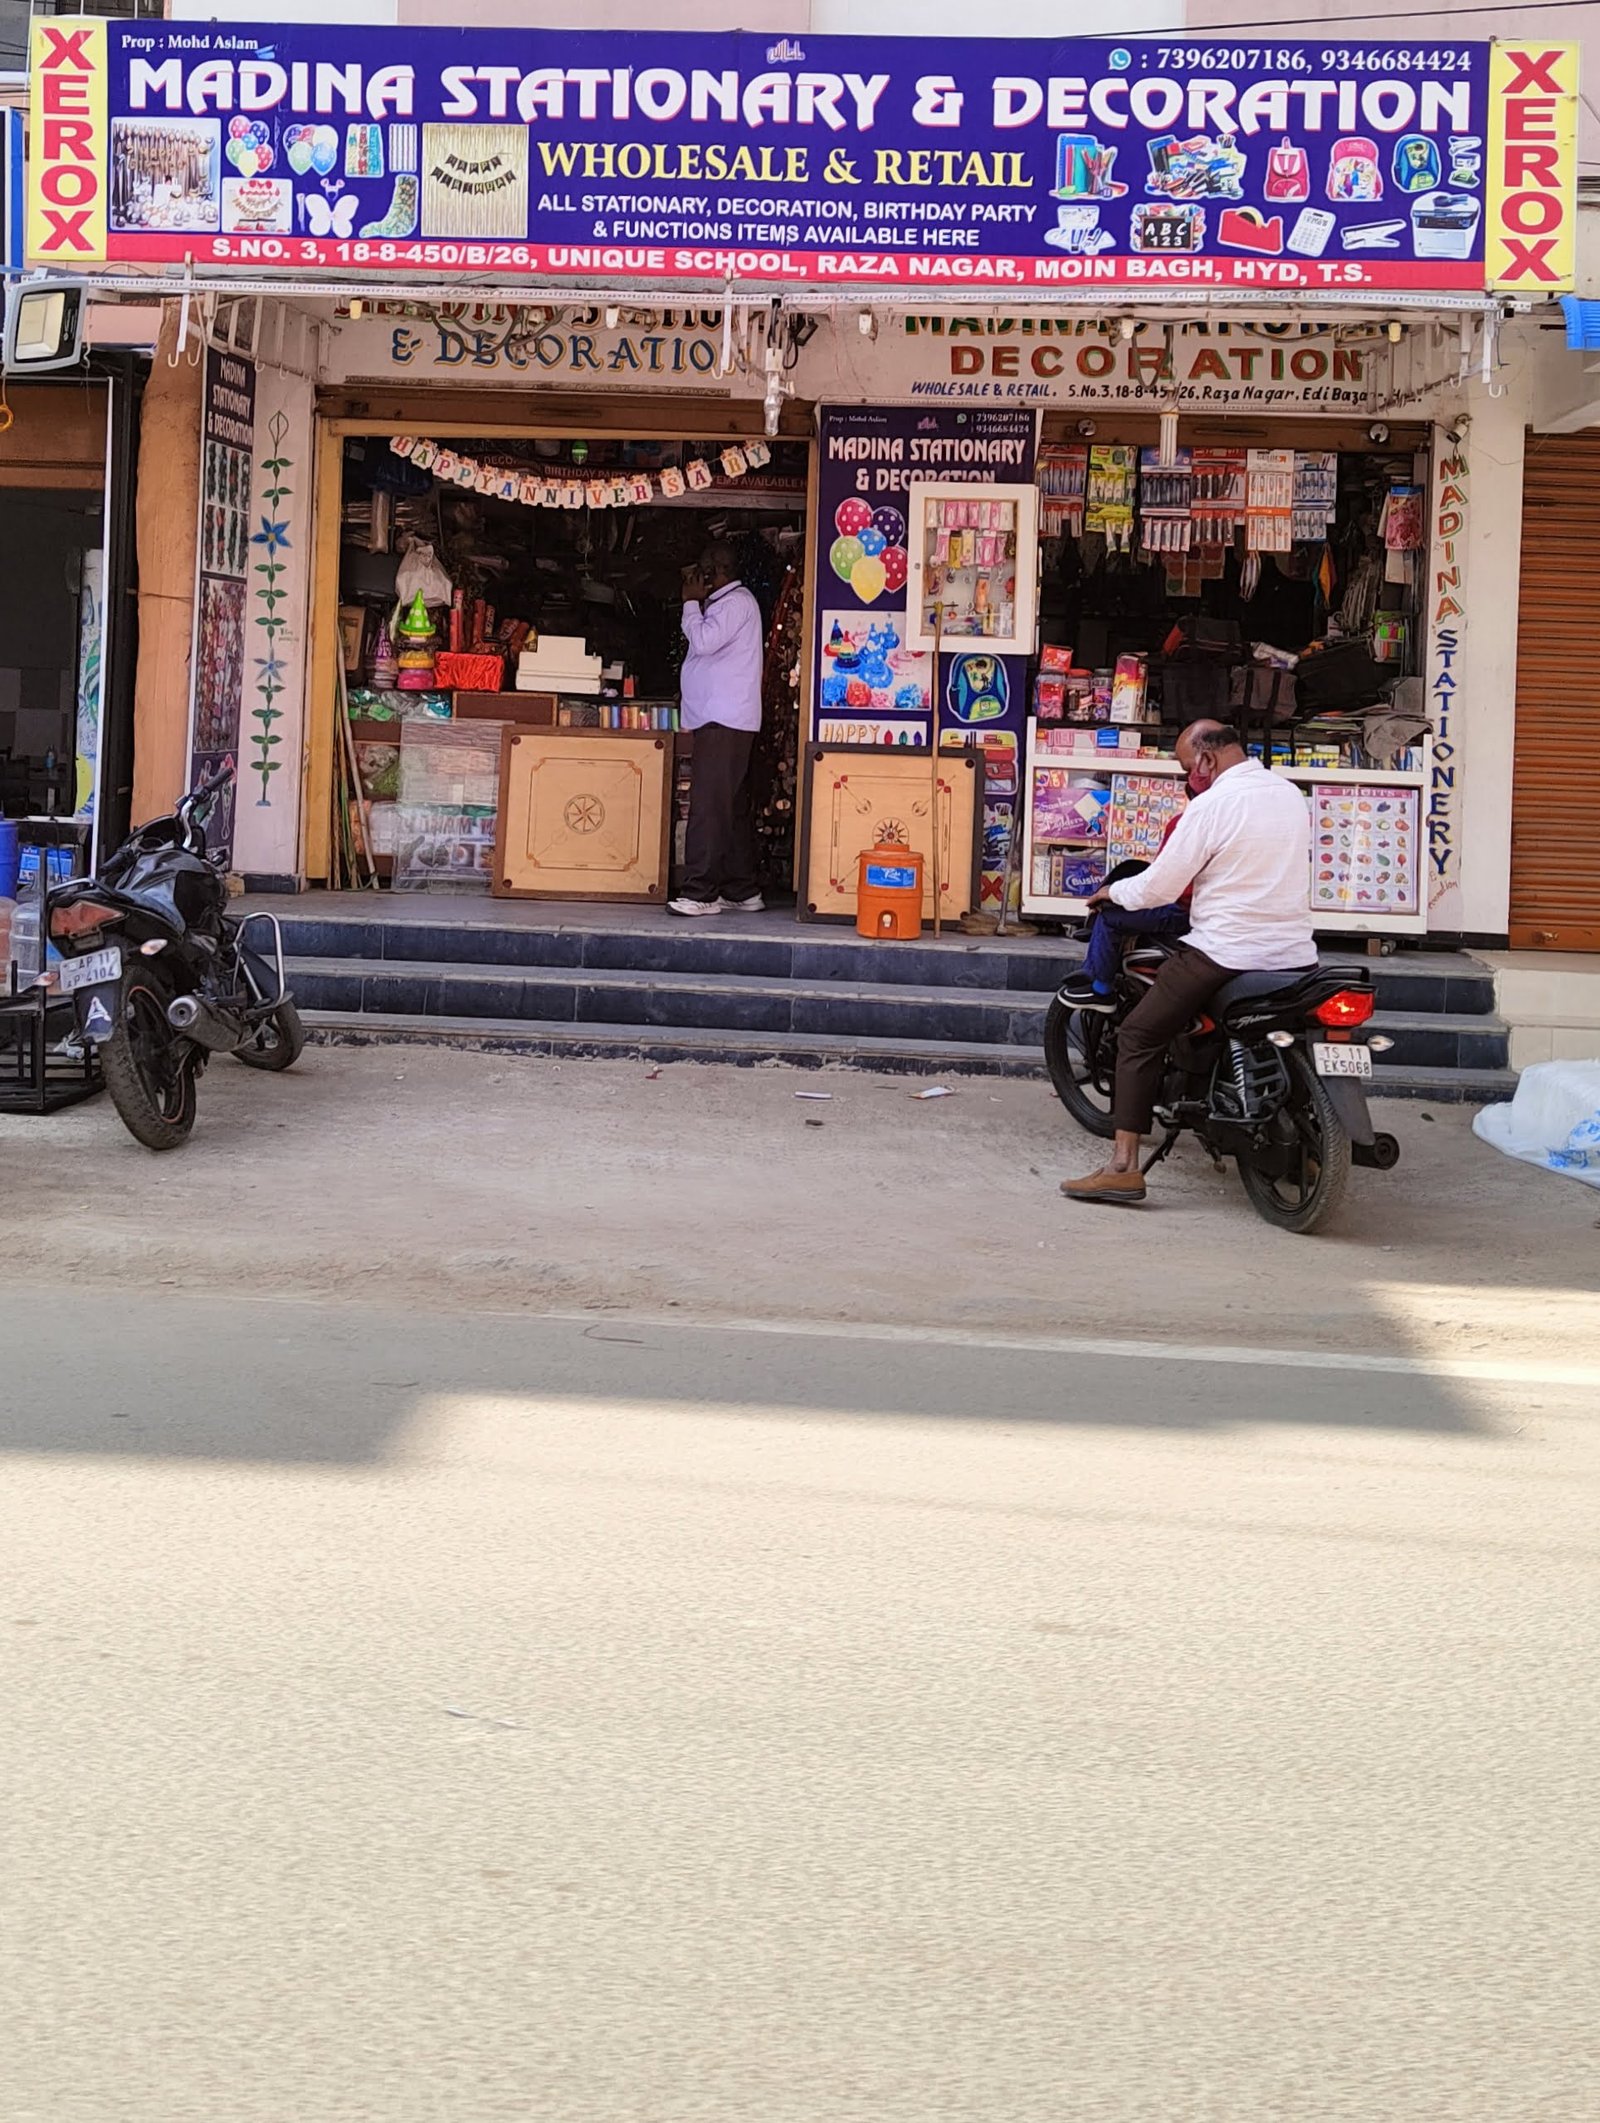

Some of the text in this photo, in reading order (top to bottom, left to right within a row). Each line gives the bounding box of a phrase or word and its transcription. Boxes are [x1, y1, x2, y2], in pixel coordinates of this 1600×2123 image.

[121, 35, 155, 50] Prop
[167, 35, 211, 50] Mohd
[213, 36, 259, 51] Aslam
[1156, 48, 1312, 73] 7396207186,
[1321, 48, 1472, 72] 9346684424
[128, 57, 1471, 136] MADINA STATIONARY & DECORATION
[39, 27, 98, 252] XEROX
[537, 141, 1034, 187] WHOLESALE & RETAIL
[1499, 50, 1567, 282] XEROX
[537, 194, 1037, 223] ALL STATIONARY, DECORATION, BIRTHDAY PARTY
[592, 221, 980, 247] & FUNCTIONS ITEMS AVAILABLE HERE
[212, 237, 1372, 285] S.NO. 3, 18-8-450/B/26, UNIQUE SCHOOL, RAZA NAGAR, MOIN BAGH, HYD, T.S.
[391, 328, 424, 366] &
[950, 345, 1364, 382] DECORATION
[828, 436, 1027, 465] MADINA STATIONARY
[855, 467, 870, 492] &
[1436, 454, 1470, 627] MADINA
[824, 723, 881, 744] HAPPY
[1429, 629, 1461, 876] STATIONERY
[1341, 788, 1395, 798] FRUITS
[1323, 1046, 1362, 1060] TS 11
[1323, 1060, 1370, 1075] EK5068
